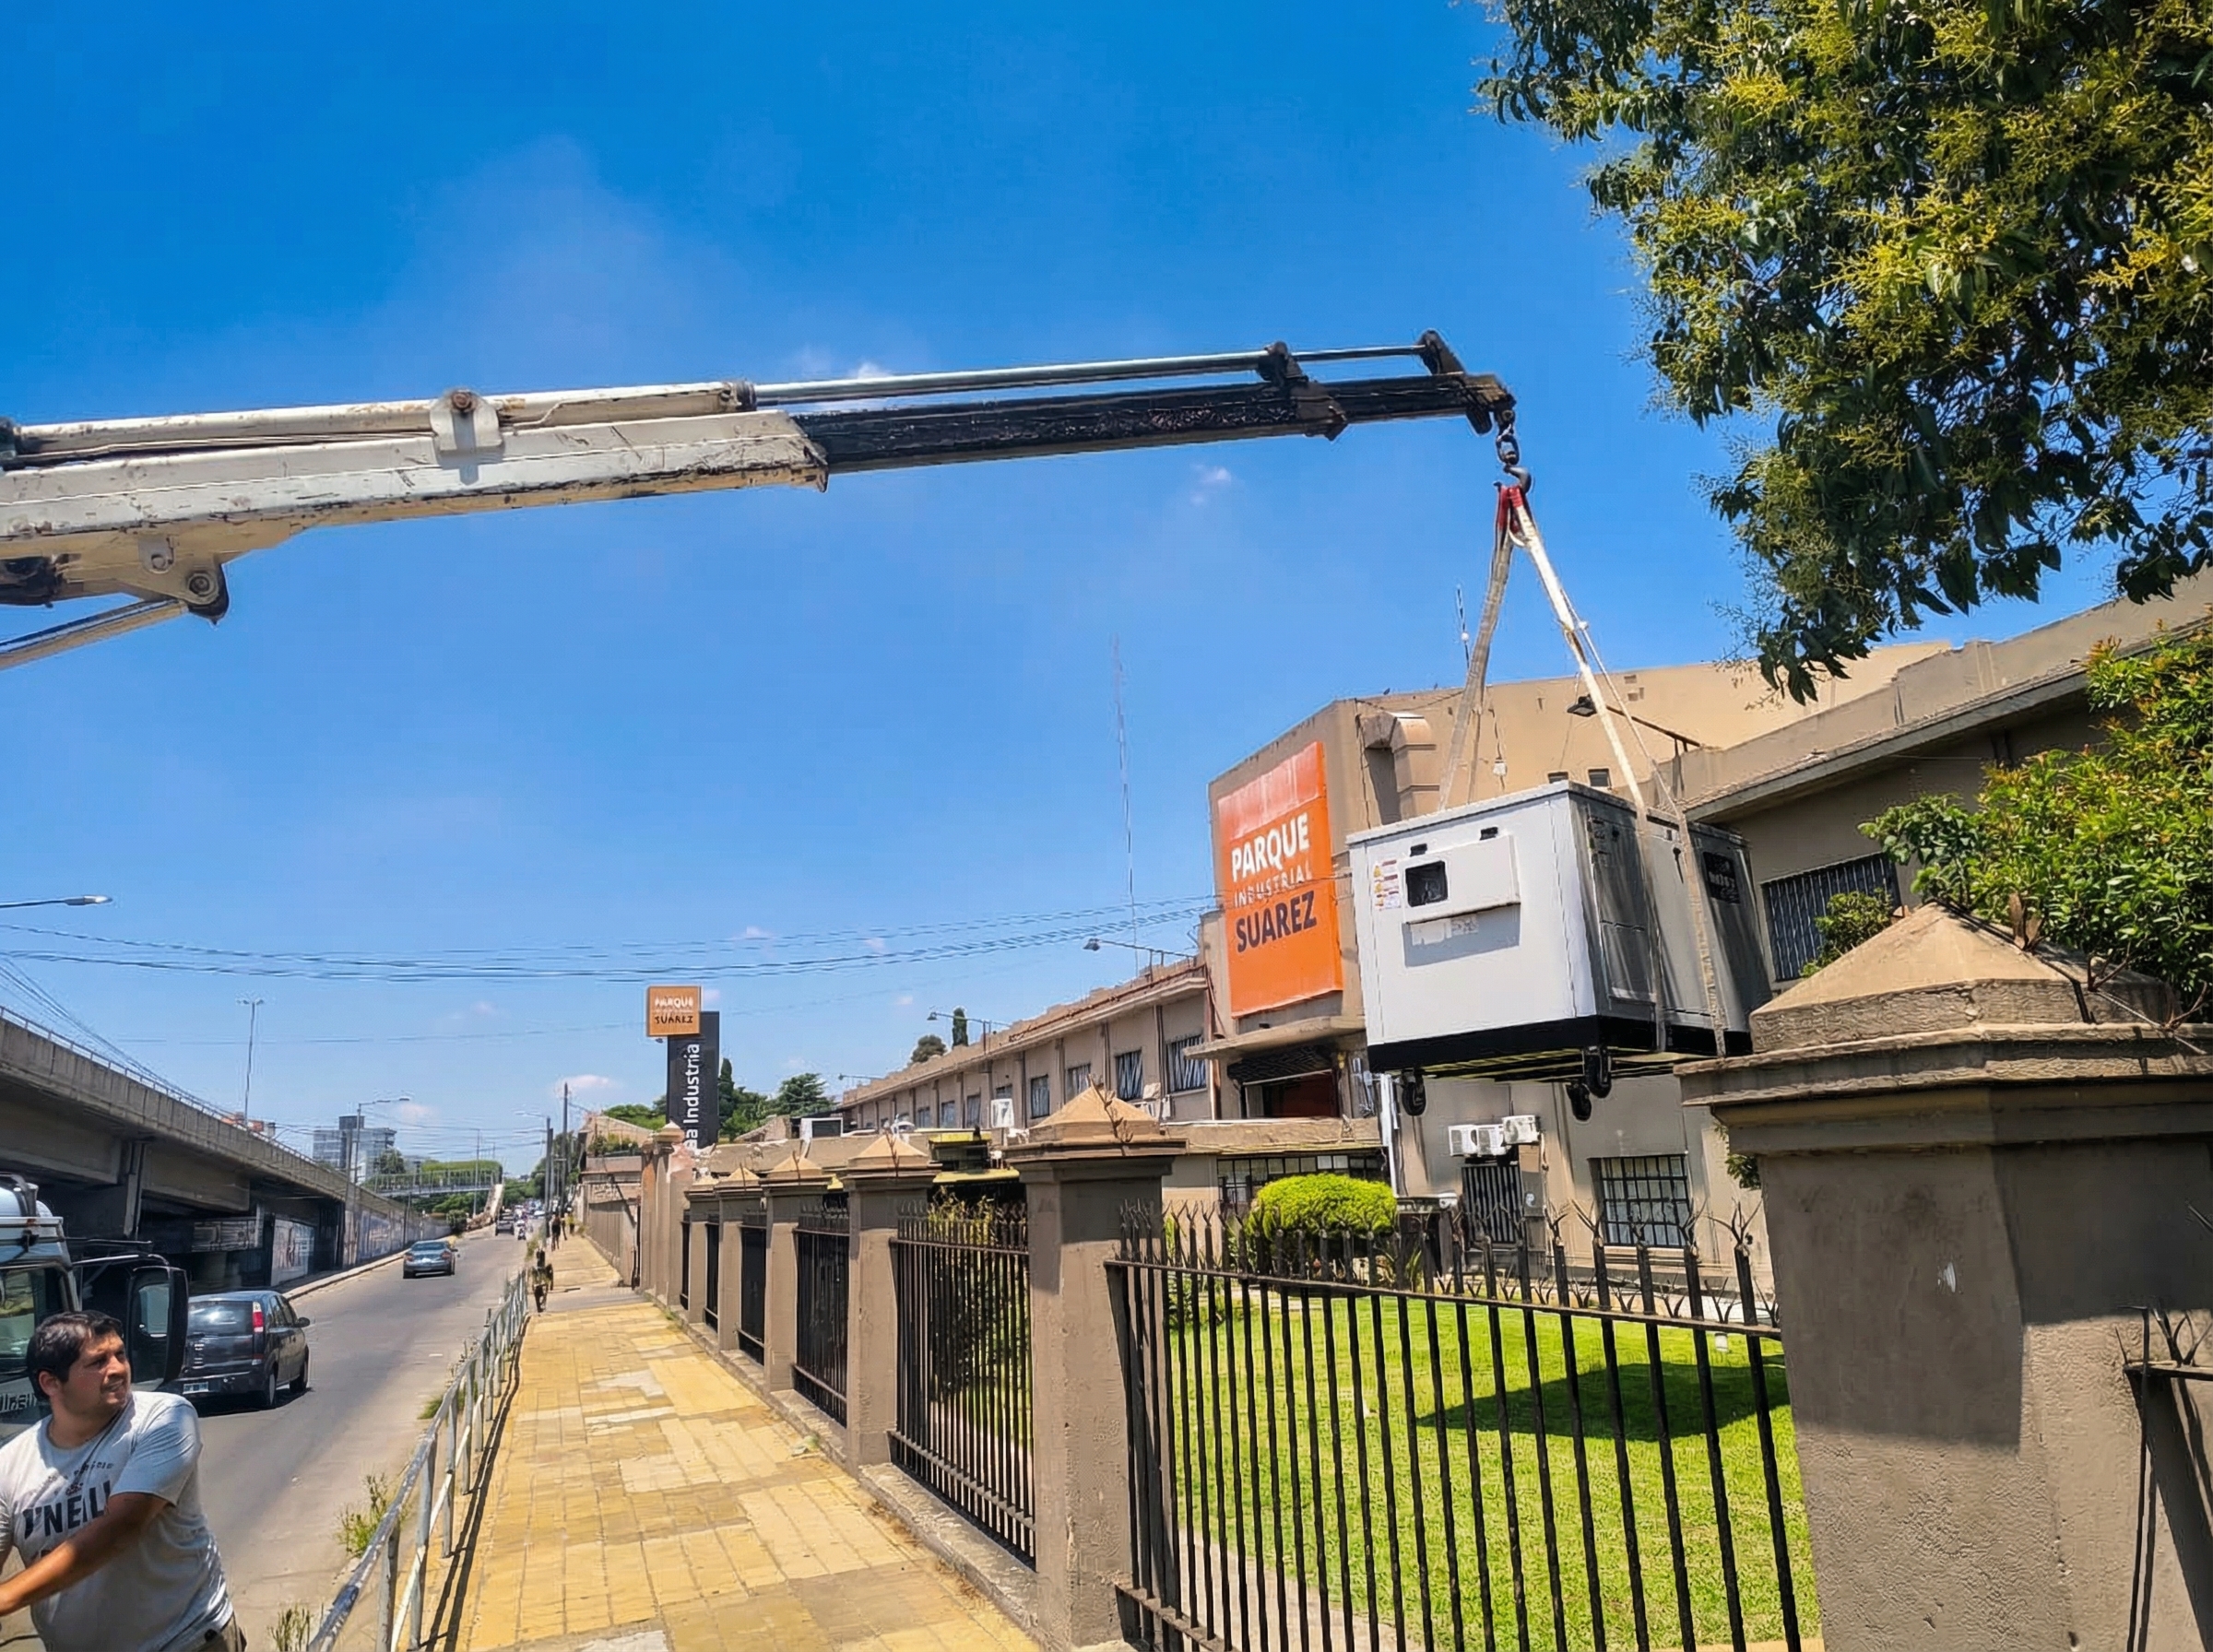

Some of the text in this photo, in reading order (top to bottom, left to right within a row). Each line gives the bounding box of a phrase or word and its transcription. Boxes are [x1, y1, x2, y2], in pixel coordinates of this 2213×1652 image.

[1231, 812, 1310, 882] PARQUE
[1234, 859, 1313, 908] INDUSTRIAL
[1237, 890, 1318, 953] SUAREZ
[682, 1044, 700, 1124] Industria
